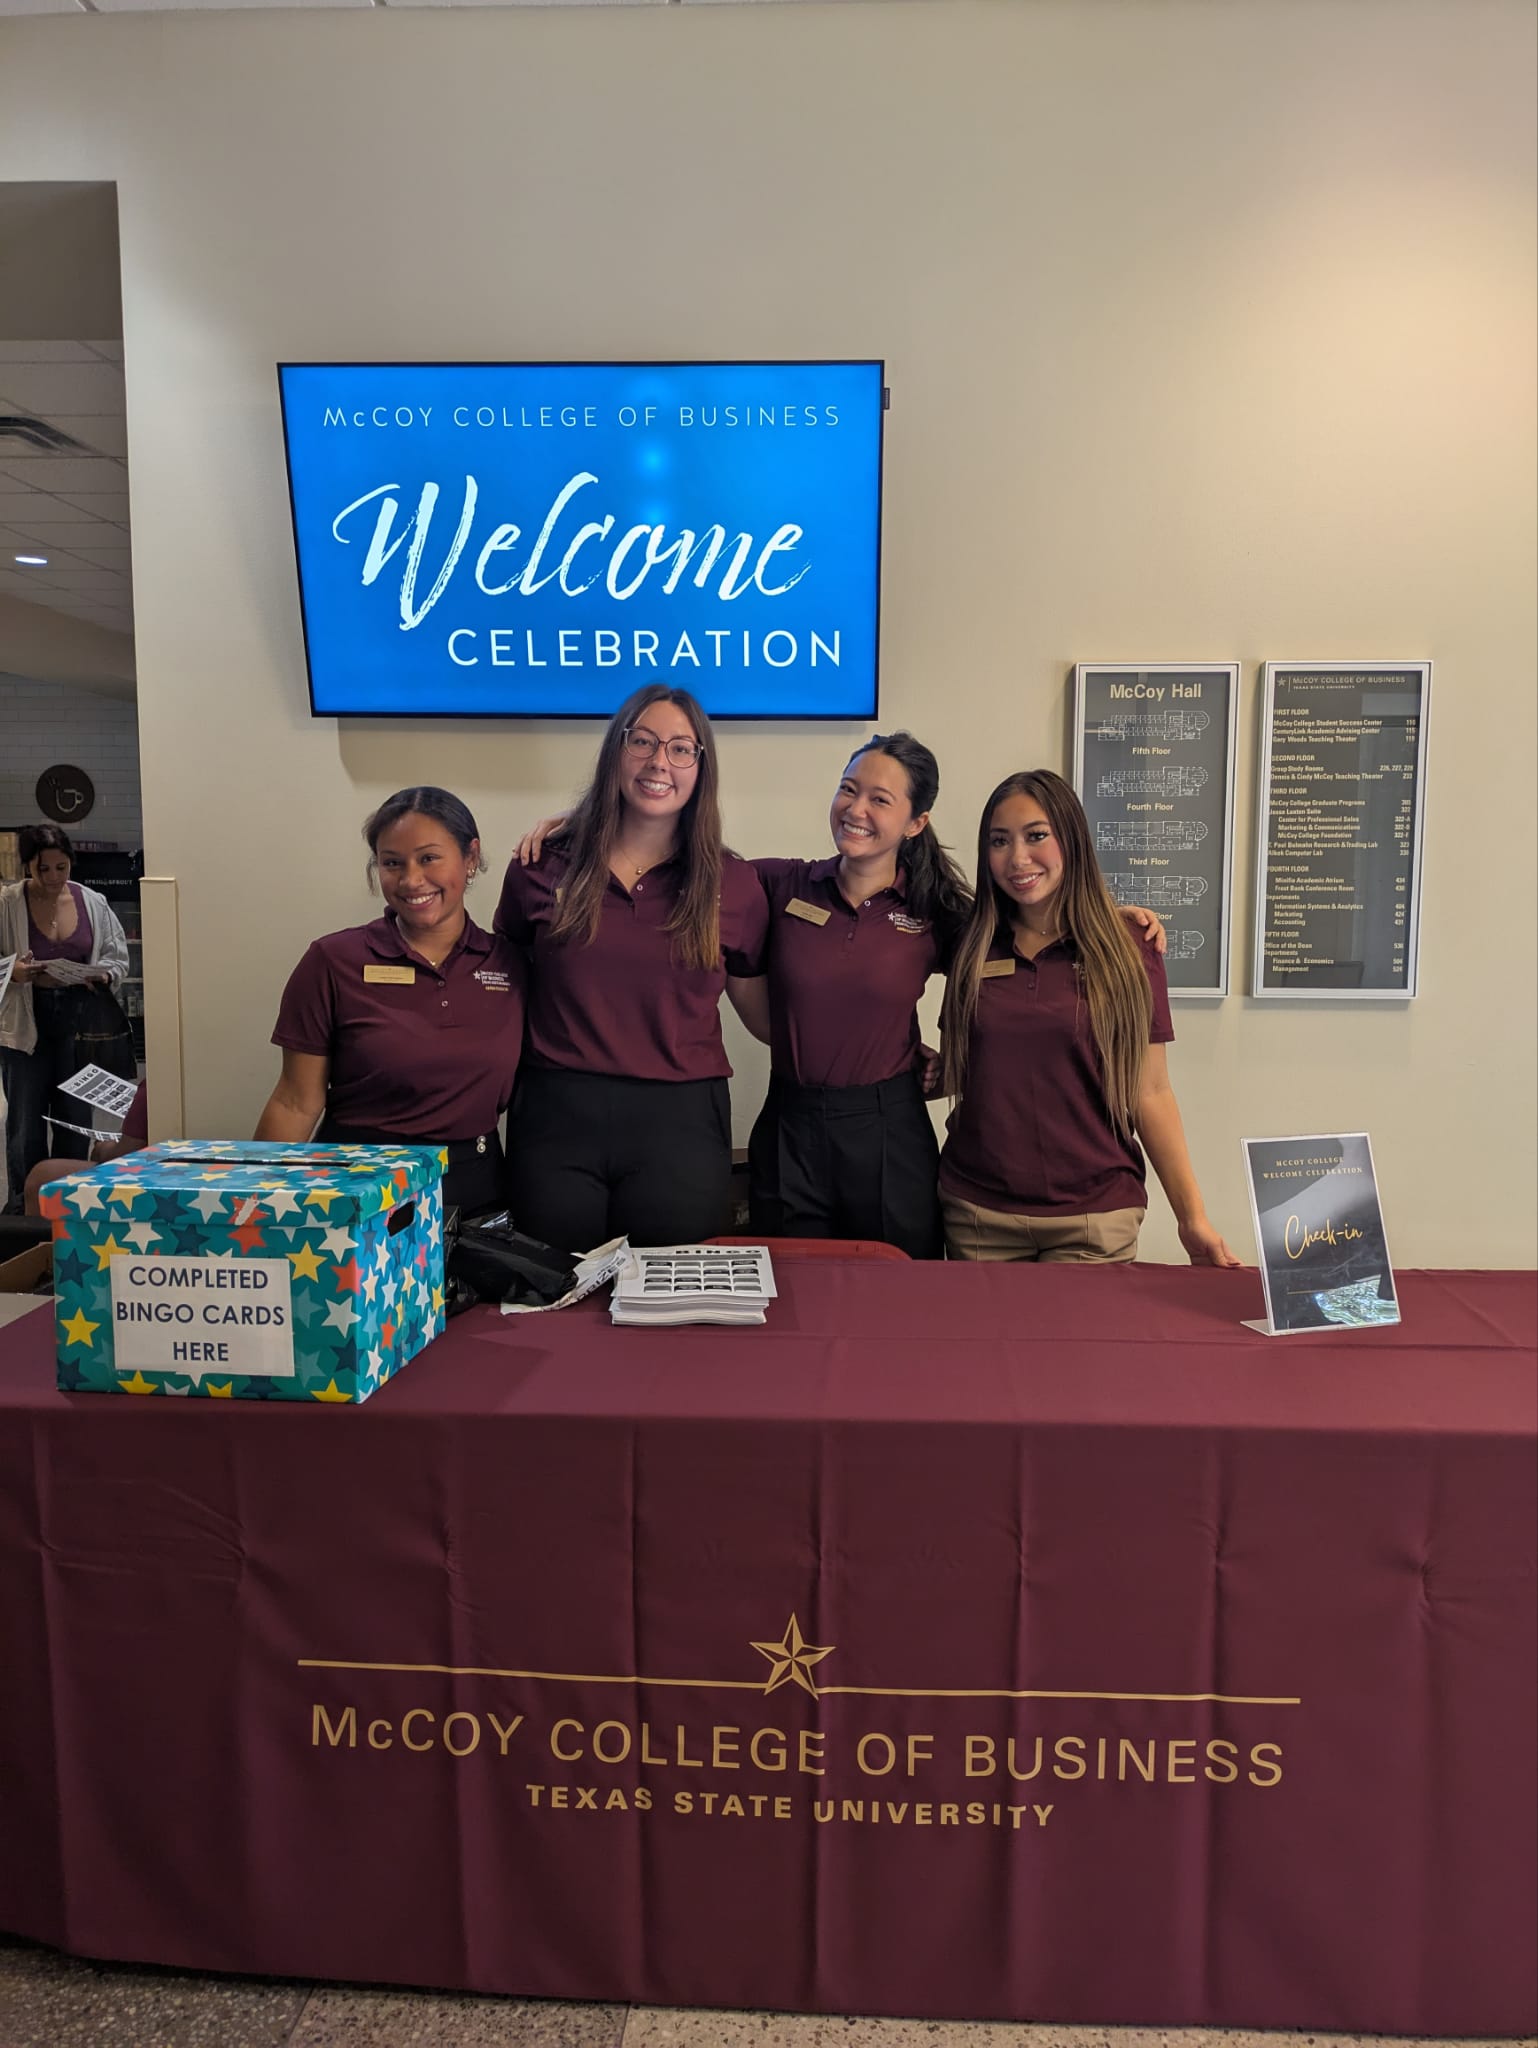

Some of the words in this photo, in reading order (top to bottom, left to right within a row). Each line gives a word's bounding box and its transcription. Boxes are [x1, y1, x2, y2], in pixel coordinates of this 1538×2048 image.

[323, 407, 432, 428] McCOY
[454, 406, 597, 427] COLLEGE
[618, 406, 657, 426] OF
[680, 406, 840, 426] BUSINESS
[332, 472, 811, 630] Welcome
[448, 630, 841, 667] CELEBRATION
[1110, 684, 1165, 701] McCoy
[1172, 684, 1202, 698] Hall
[74, 1068, 99, 1087] BINGO
[1308, 1157, 1343, 1165] COLLEGE
[1263, 1170, 1302, 1179] WELCOME
[1306, 1167, 1362, 1177] CELEBRATION
[1285, 1215, 1363, 1259] Check-in
[129, 1266, 268, 1289] COMPLETED
[116, 1302, 194, 1323] BINGO
[203, 1305, 284, 1325] CARDS
[173, 1342, 228, 1361] HERE
[312, 1704, 524, 1756] McCOY
[550, 1719, 826, 1775] COLLEGE
[857, 1733, 934, 1777] OF
[965, 1735, 1283, 1786] BUSINESS
[526, 1784, 653, 1810] TEXAS
[674, 1792, 792, 1819] STATE
[814, 1800, 1055, 1829] UNIVERSITY
